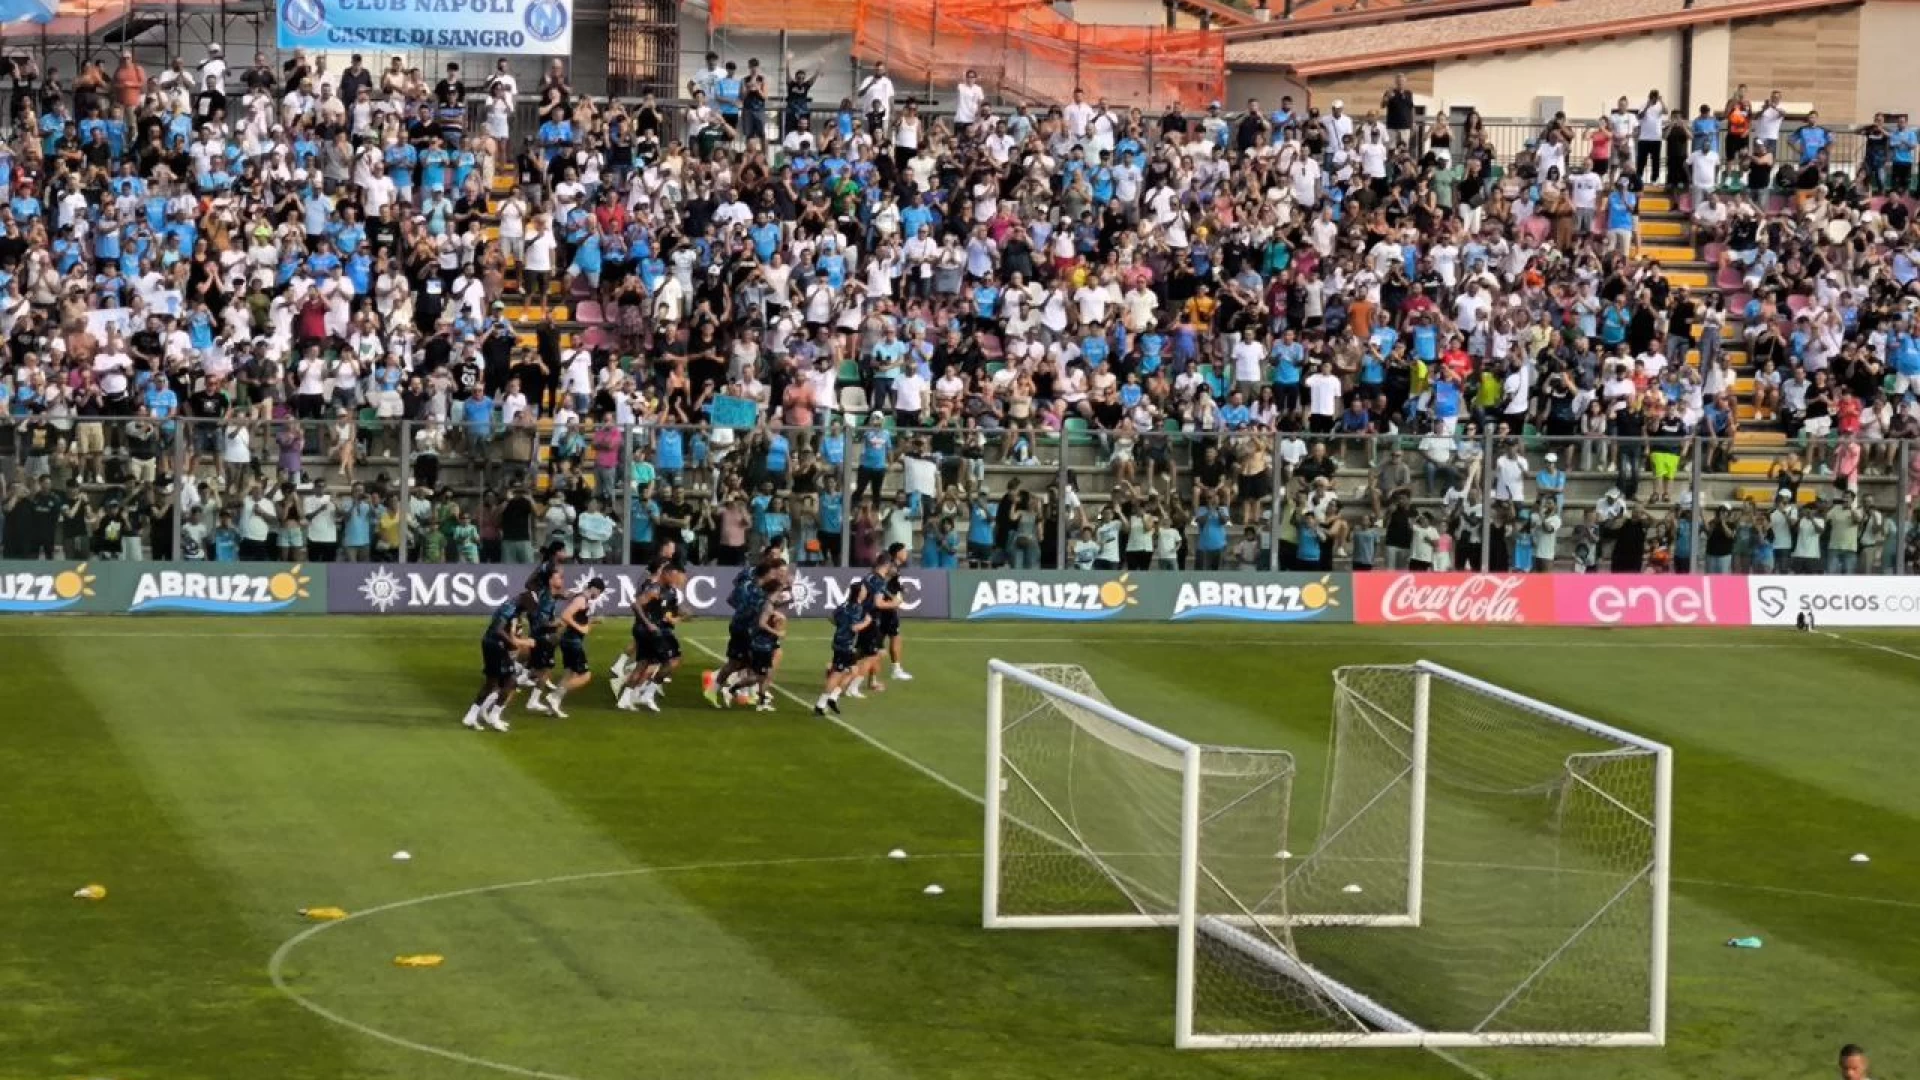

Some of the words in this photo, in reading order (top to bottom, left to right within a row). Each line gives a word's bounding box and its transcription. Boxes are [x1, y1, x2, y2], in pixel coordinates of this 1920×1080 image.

[413, 0, 514, 12] NAPOLI
[327, 26, 406, 44] CASTEL
[410, 28, 434, 46] DI
[438, 29, 525, 48] SANGRO
[407, 572, 509, 607] MSC
[1381, 573, 1526, 621] Coca-Cola
[1589, 576, 1717, 623] enel
